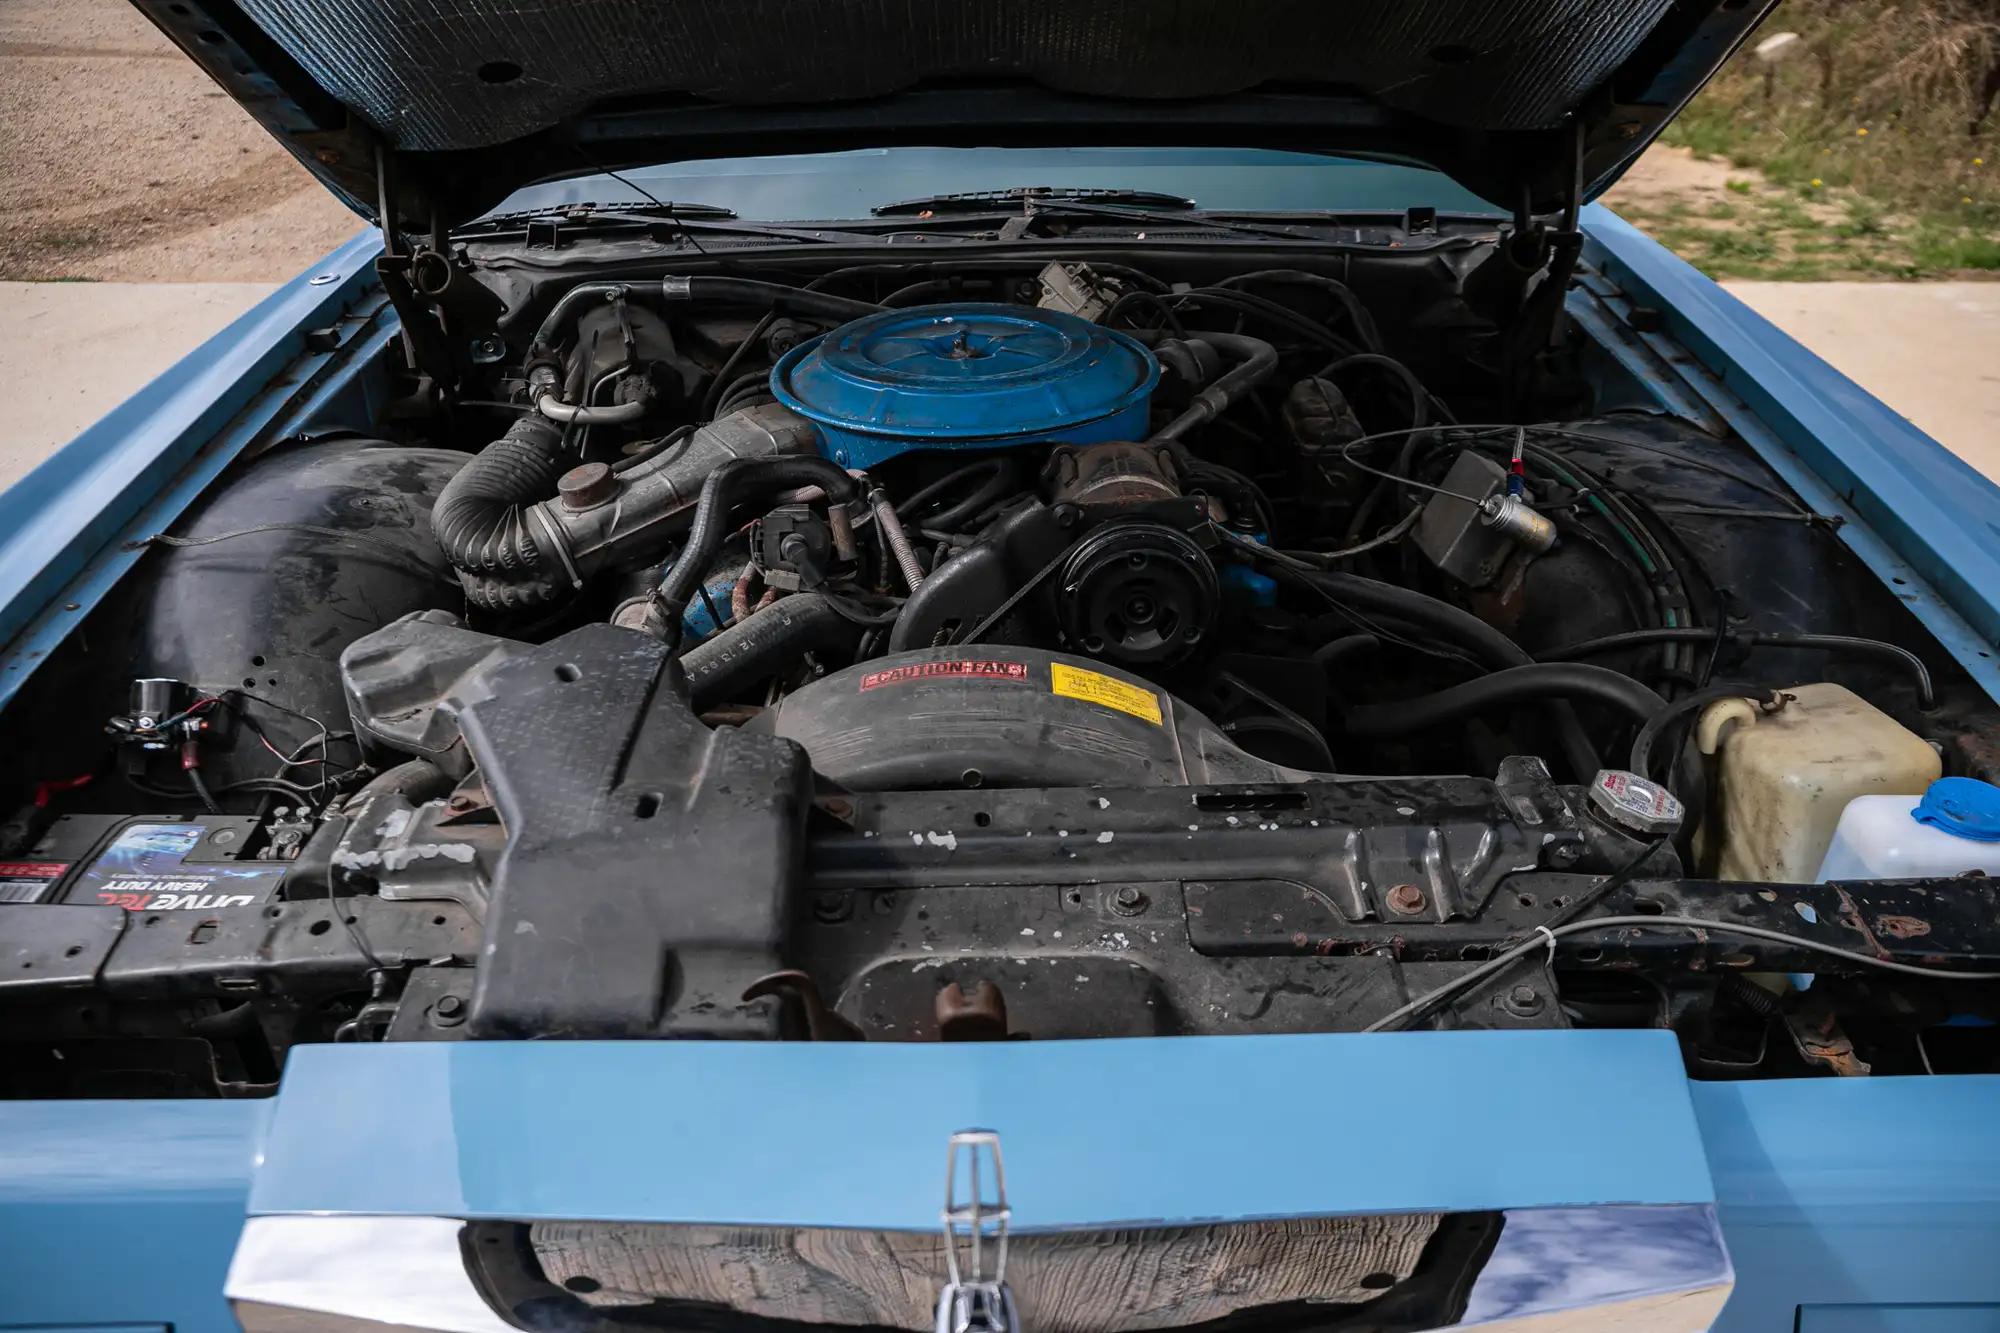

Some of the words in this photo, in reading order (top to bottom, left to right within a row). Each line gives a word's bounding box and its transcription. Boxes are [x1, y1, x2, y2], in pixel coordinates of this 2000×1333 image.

[739, 638, 755, 651] 12
[721, 650, 737, 662] 13
[687, 671, 697, 682] A
[877, 661, 962, 683] CAUTION
[971, 662, 1008, 674] FAN
[100, 880, 152, 891] DUTY
[149, 881, 209, 892] HEAVY
